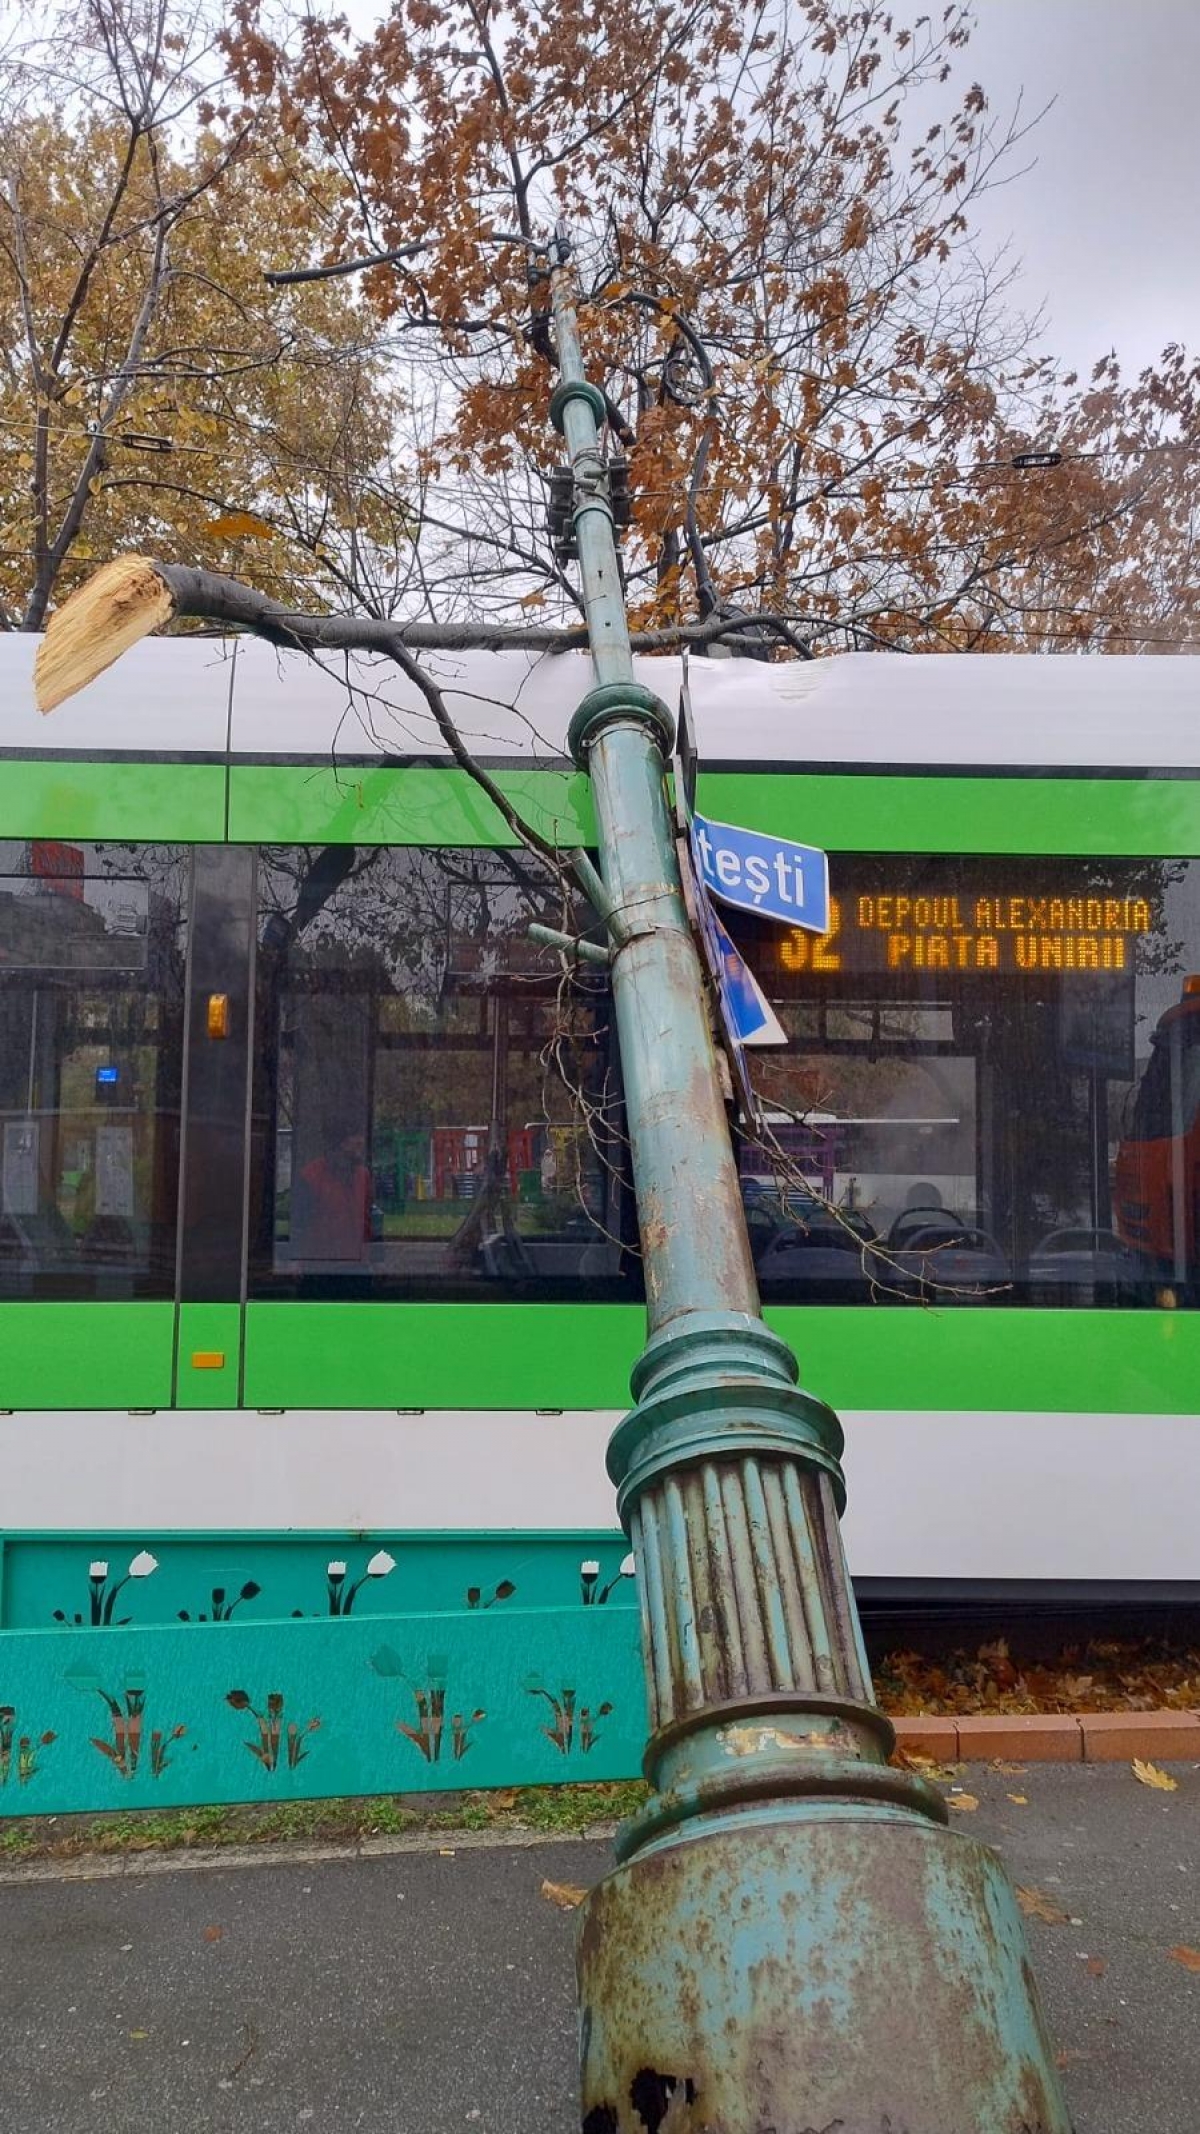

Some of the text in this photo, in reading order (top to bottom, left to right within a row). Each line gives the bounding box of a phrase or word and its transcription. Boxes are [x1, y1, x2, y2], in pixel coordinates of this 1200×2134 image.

[858, 896, 1150, 931] DEPOUL ALEXANDRIA
[887, 934, 1125, 969] PIATA UNIRII
